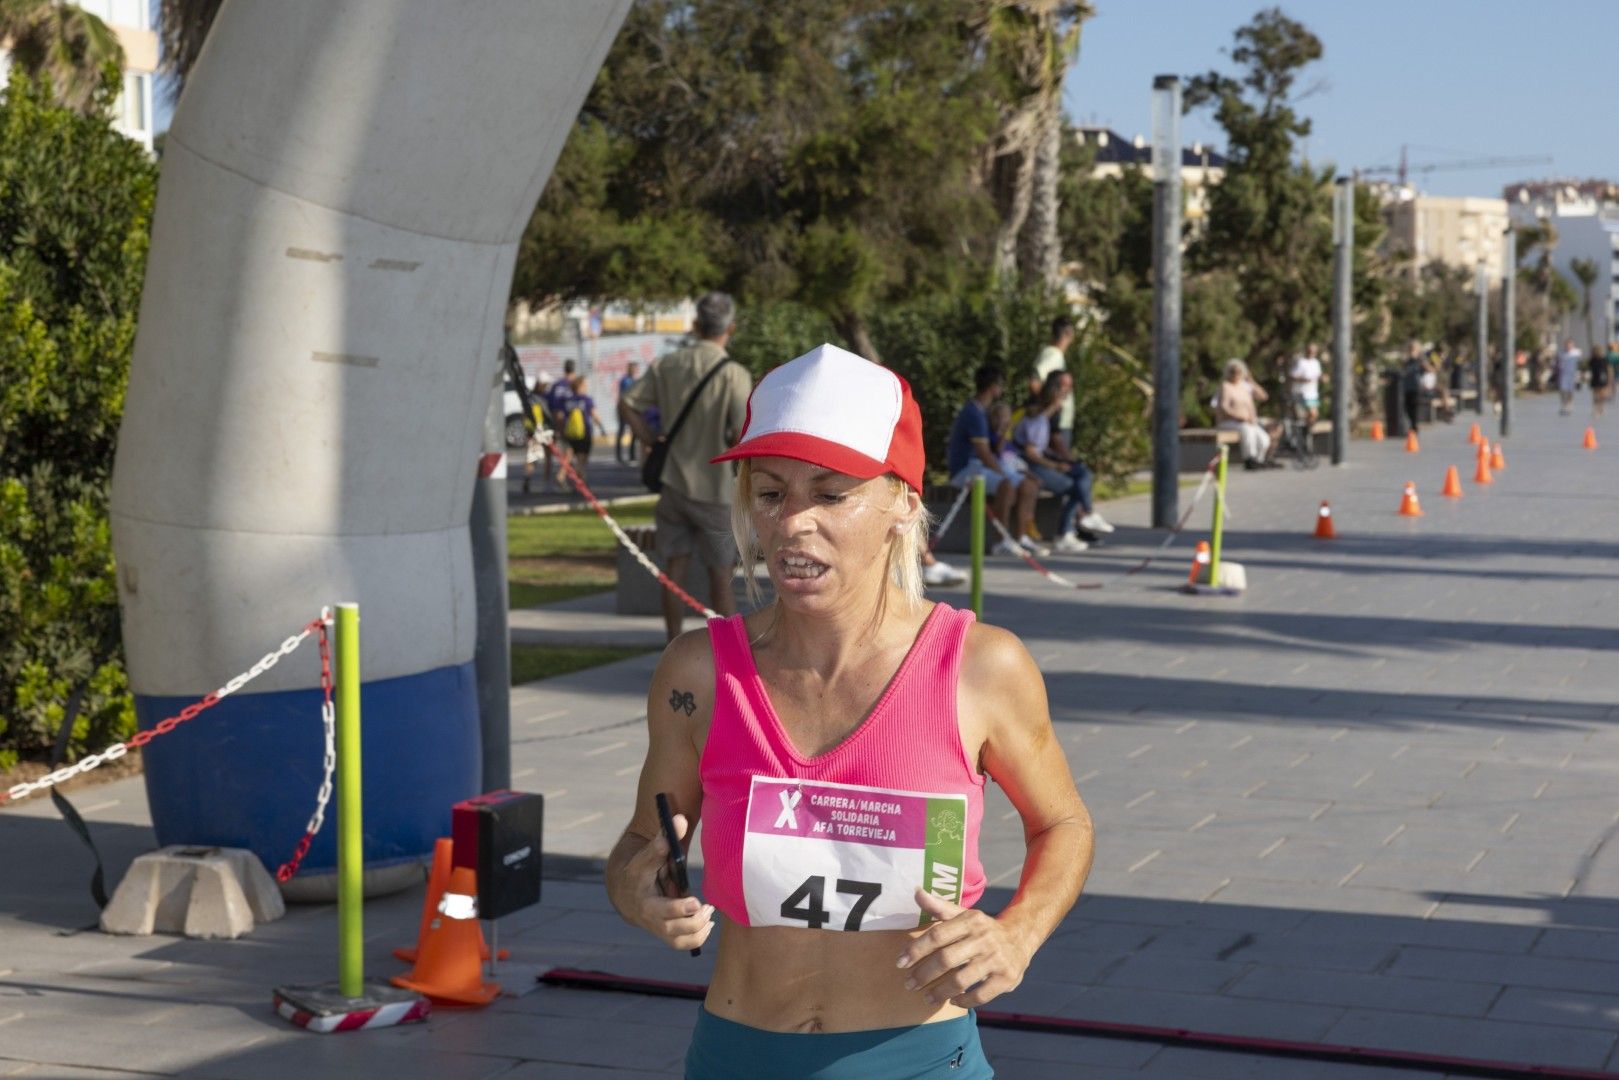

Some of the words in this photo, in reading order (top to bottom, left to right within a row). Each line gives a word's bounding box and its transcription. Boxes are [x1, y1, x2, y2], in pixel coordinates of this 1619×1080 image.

[774, 789, 803, 830] X
[811, 795, 901, 815] CARRERA/MARCHA
[831, 810, 880, 826] SOLIDARIA
[813, 821, 834, 833] AFA
[838, 824, 896, 841] TORREVIEJA
[781, 875, 882, 932] 47
